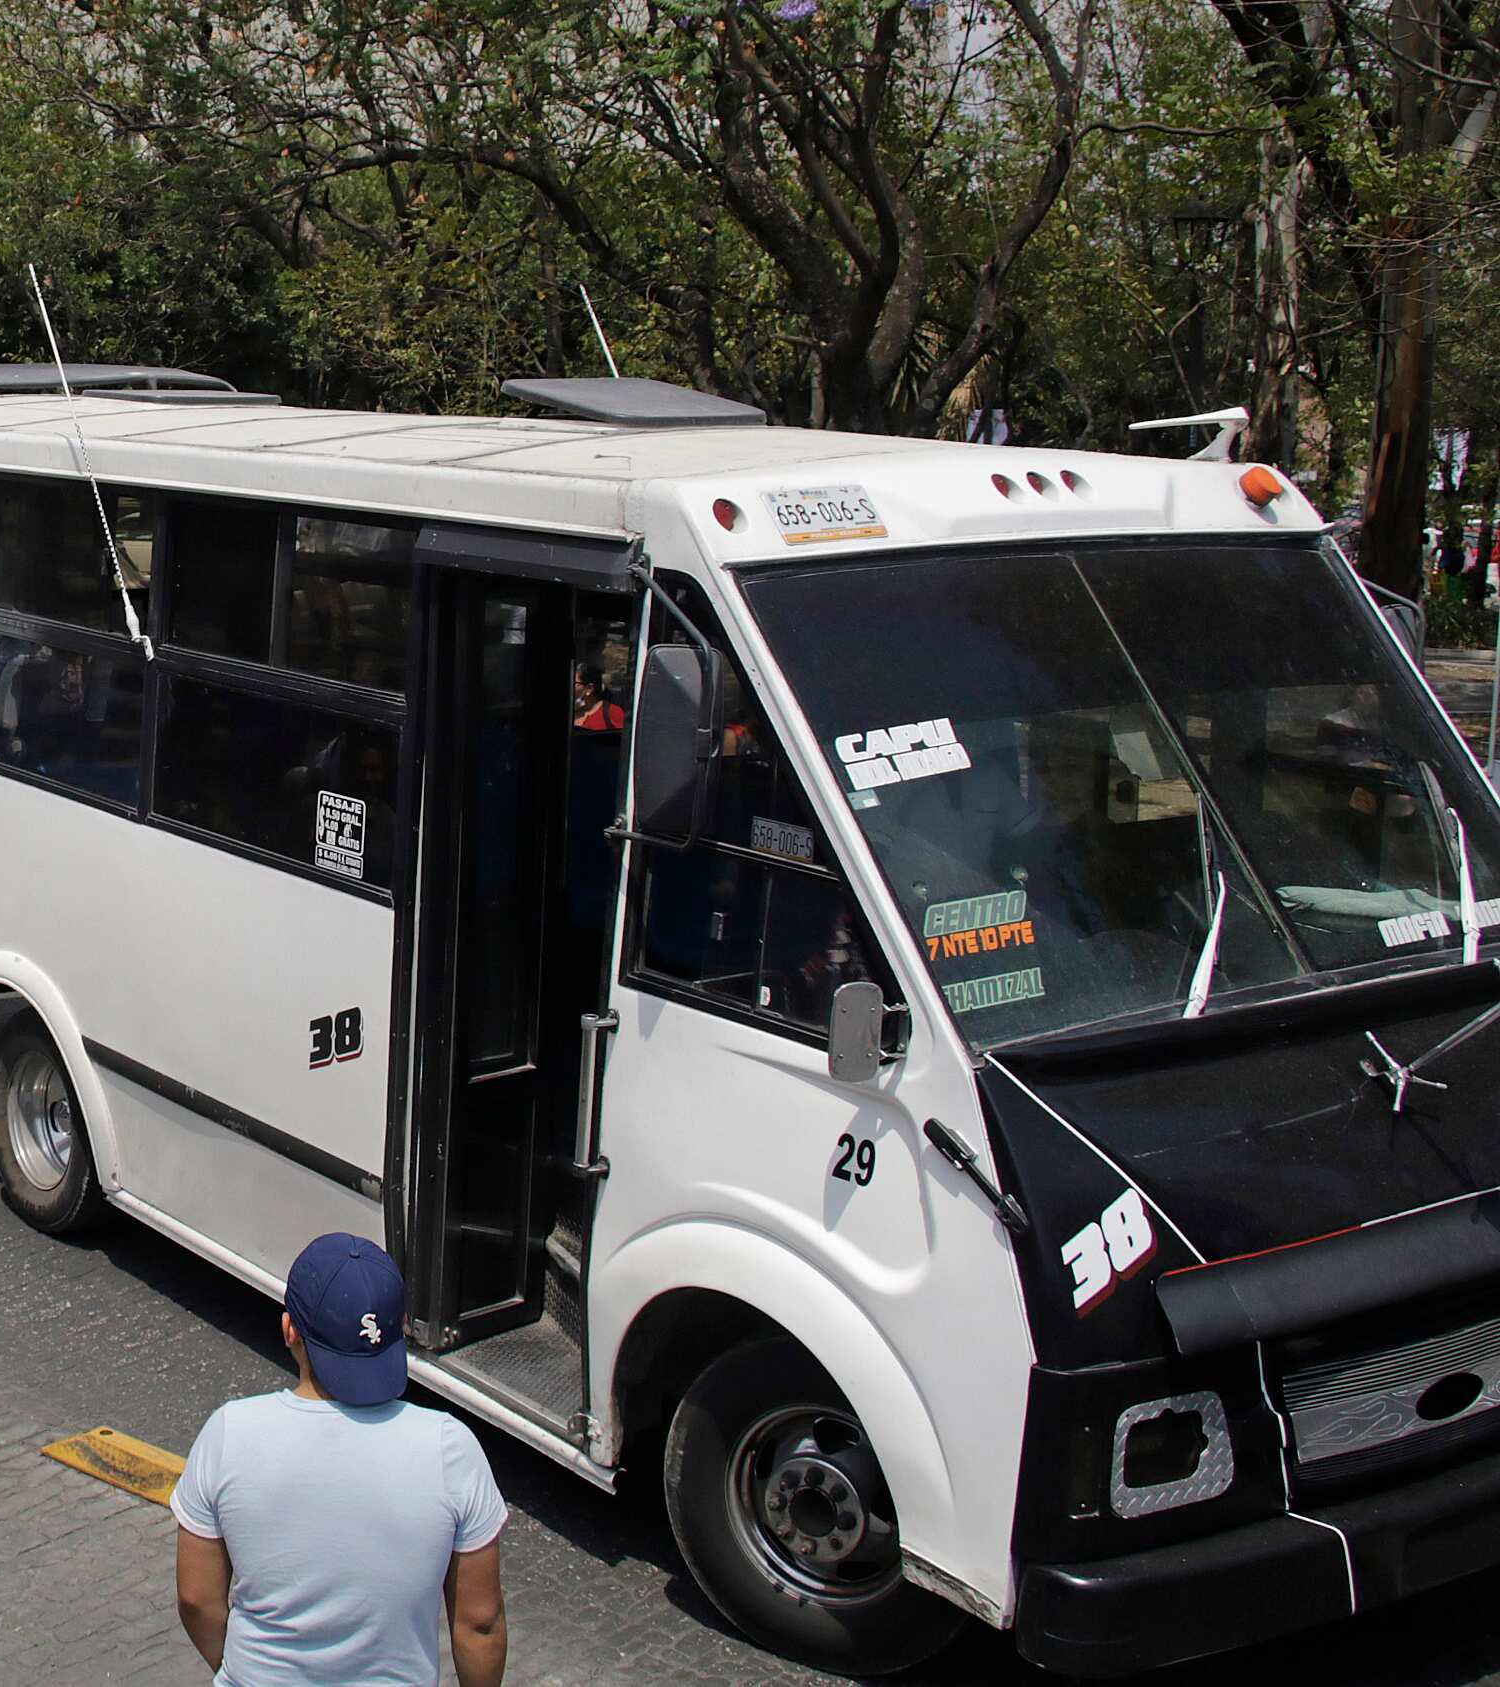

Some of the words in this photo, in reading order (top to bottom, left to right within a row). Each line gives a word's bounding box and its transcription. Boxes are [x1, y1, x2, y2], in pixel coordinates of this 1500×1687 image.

[777, 498, 876, 525] 658-006-S
[835, 717, 957, 763] CAPU
[322, 795, 362, 814] PASAJE
[752, 822, 813, 858] 658-006-S
[924, 890, 1027, 938] CENTRO
[926, 937, 940, 960] 7
[942, 930, 979, 958] NTE
[980, 927, 999, 951] 10
[998, 920, 1035, 948] PTE
[309, 1007, 363, 1069] 38
[832, 1133, 876, 1186] 29
[1061, 1187, 1155, 1314] 38
